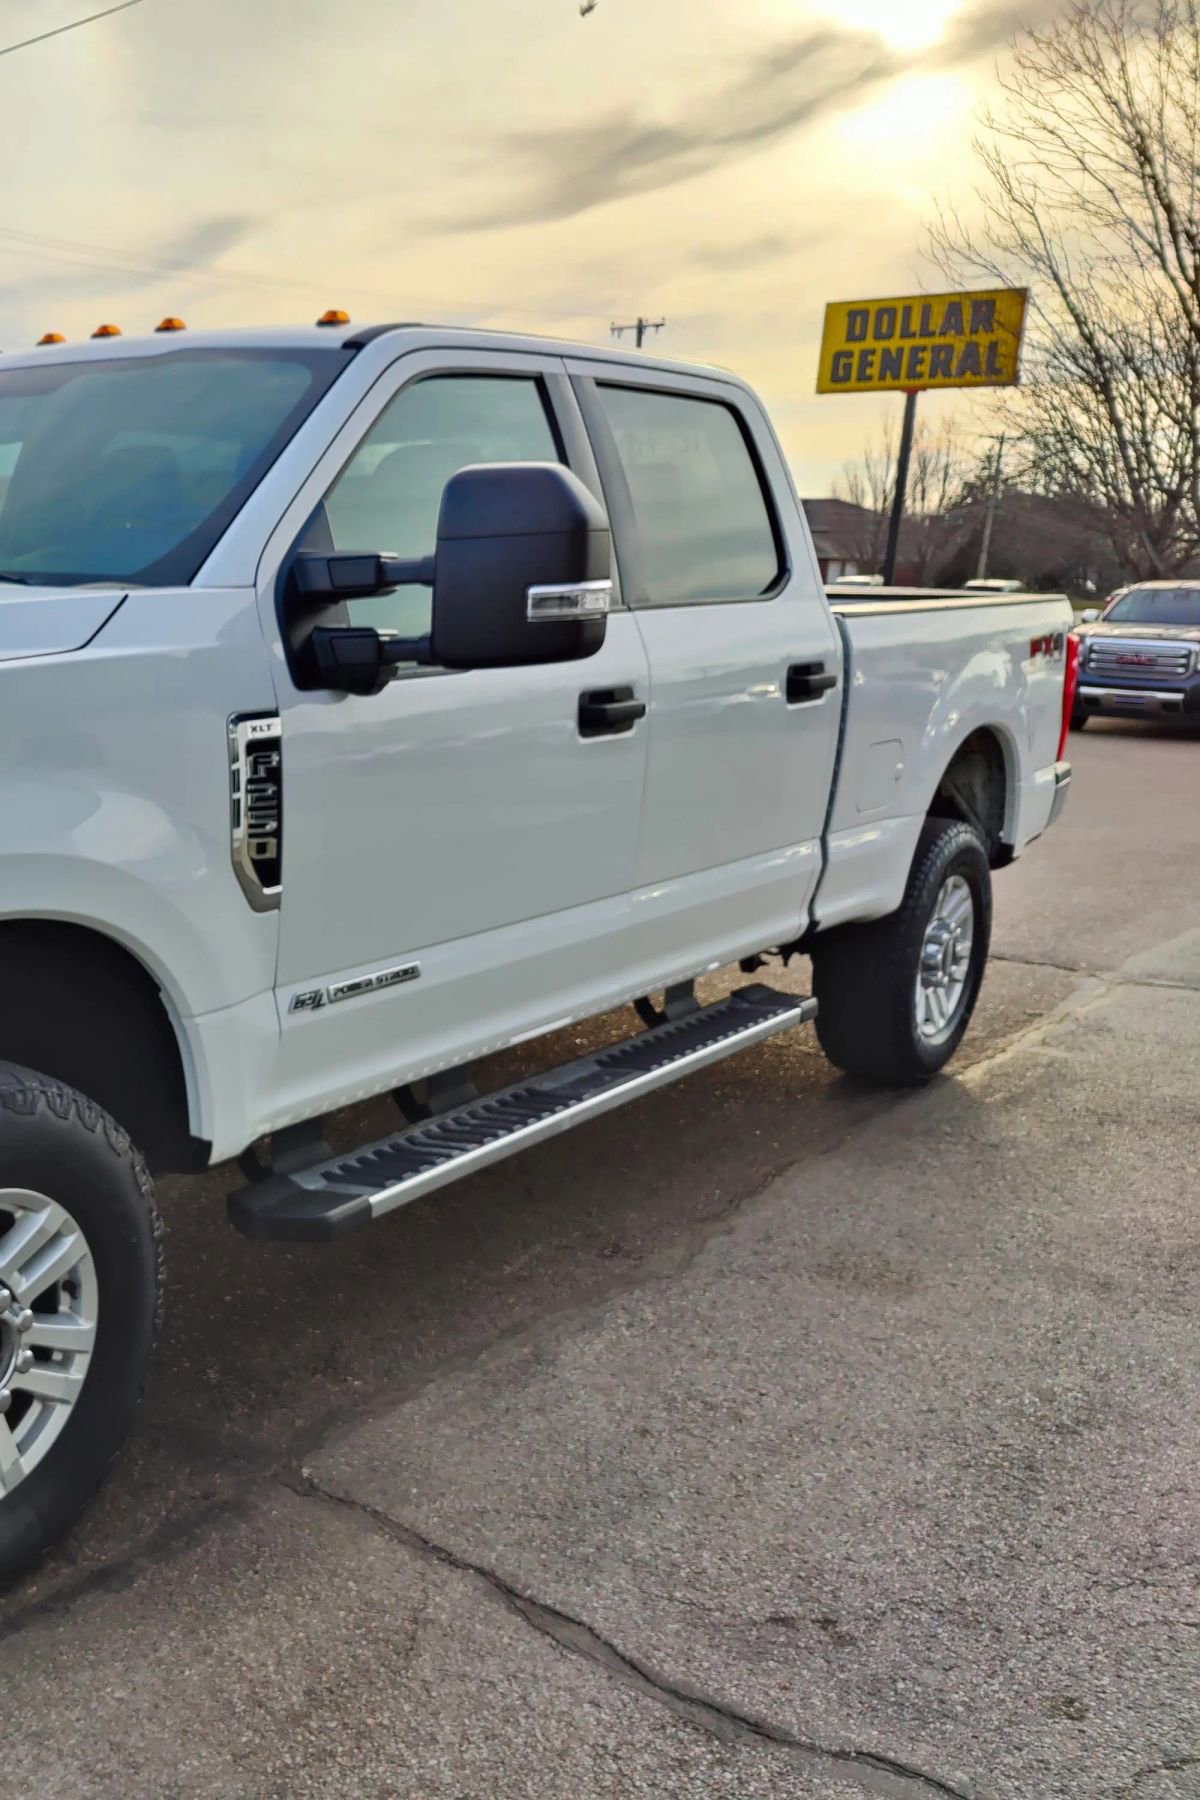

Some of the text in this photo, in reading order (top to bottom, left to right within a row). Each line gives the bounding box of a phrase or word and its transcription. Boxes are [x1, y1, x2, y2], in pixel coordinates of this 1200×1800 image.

[845, 299, 997, 342] DOLLAR
[830, 341, 1004, 383] GENERAL
[250, 724, 273, 734] XLT
